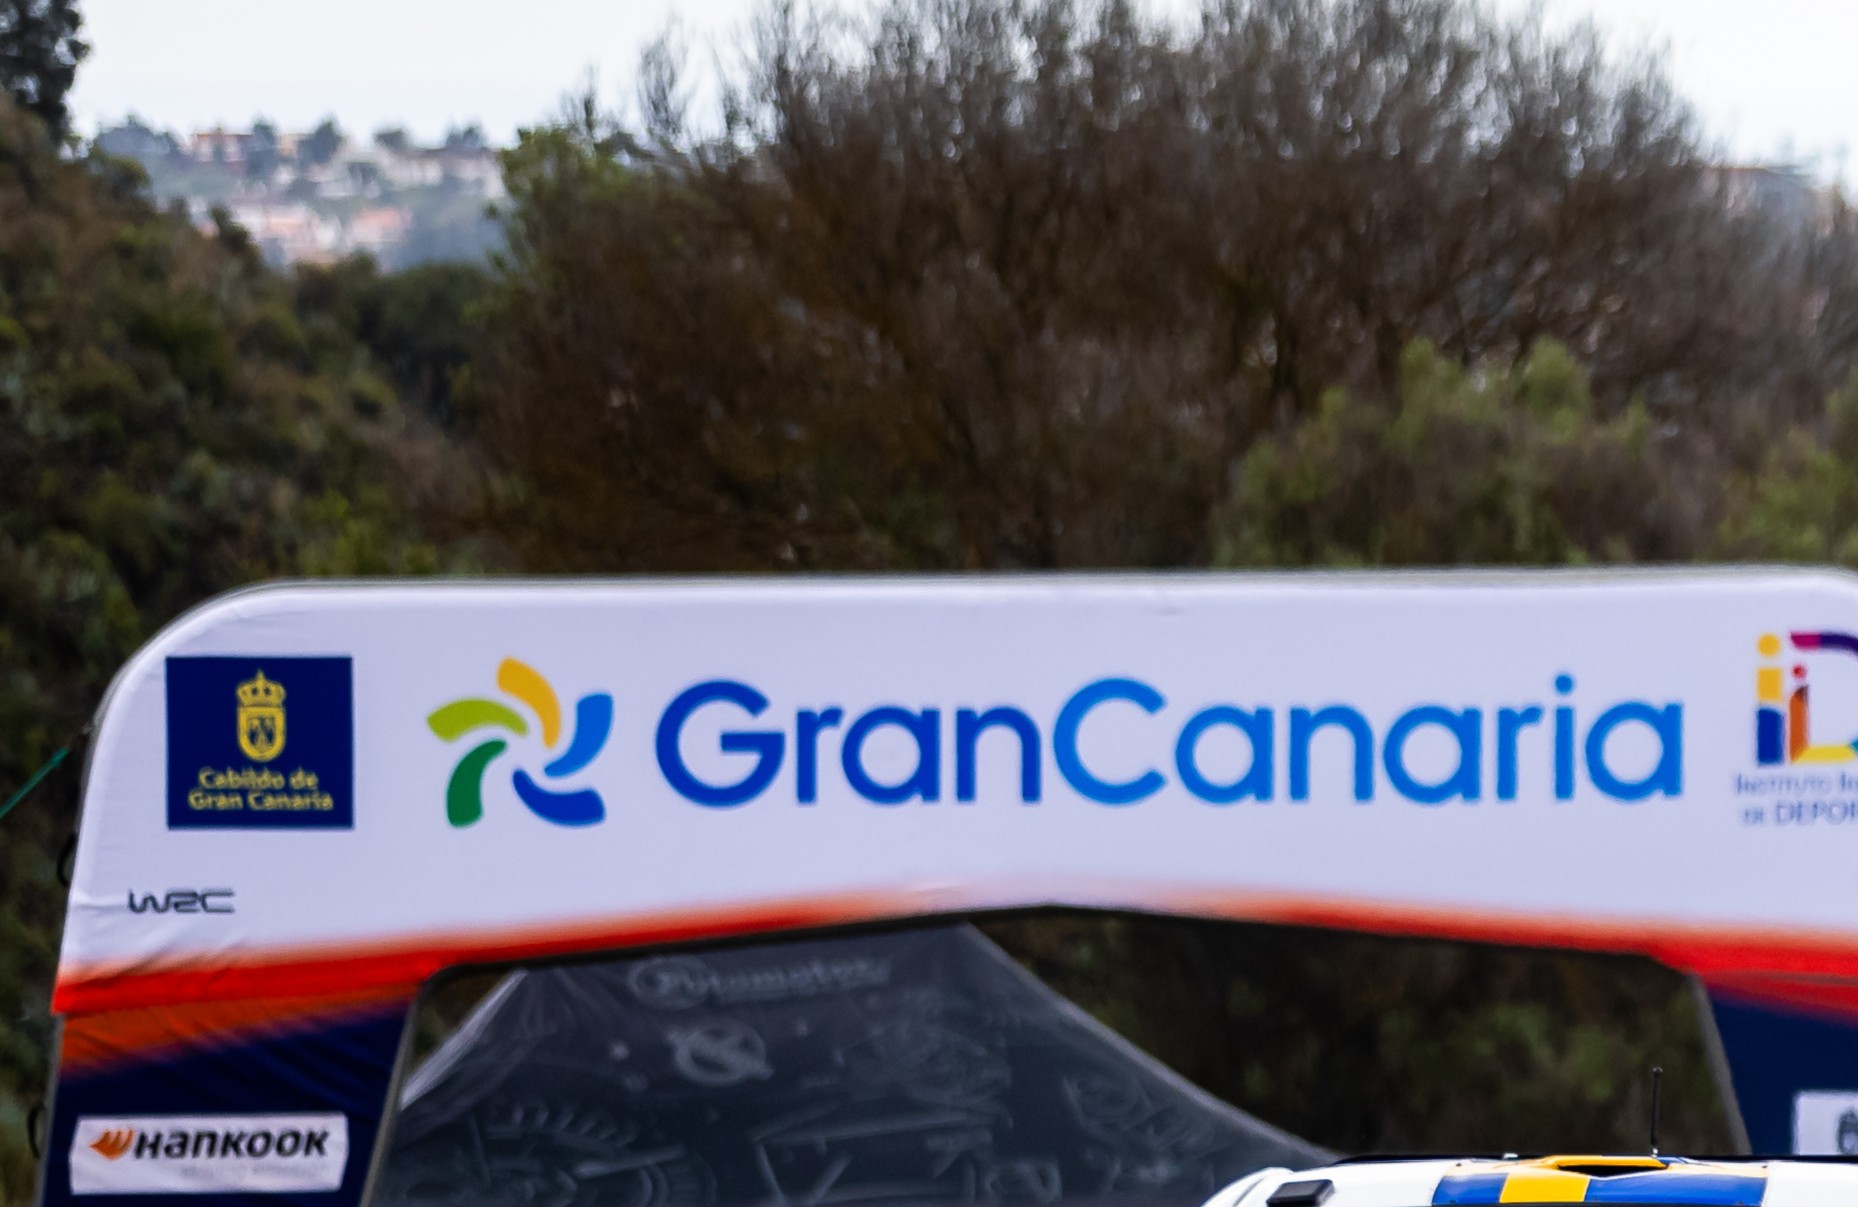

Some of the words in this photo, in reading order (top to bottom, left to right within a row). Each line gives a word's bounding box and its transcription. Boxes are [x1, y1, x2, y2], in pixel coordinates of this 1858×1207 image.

[655, 674, 1684, 810] GranCanaria
[199, 767, 285, 789] Cabildo
[289, 767, 318, 789] de
[188, 790, 243, 810] Gran
[248, 790, 333, 811] Canaria
[128, 889, 235, 913] WRC
